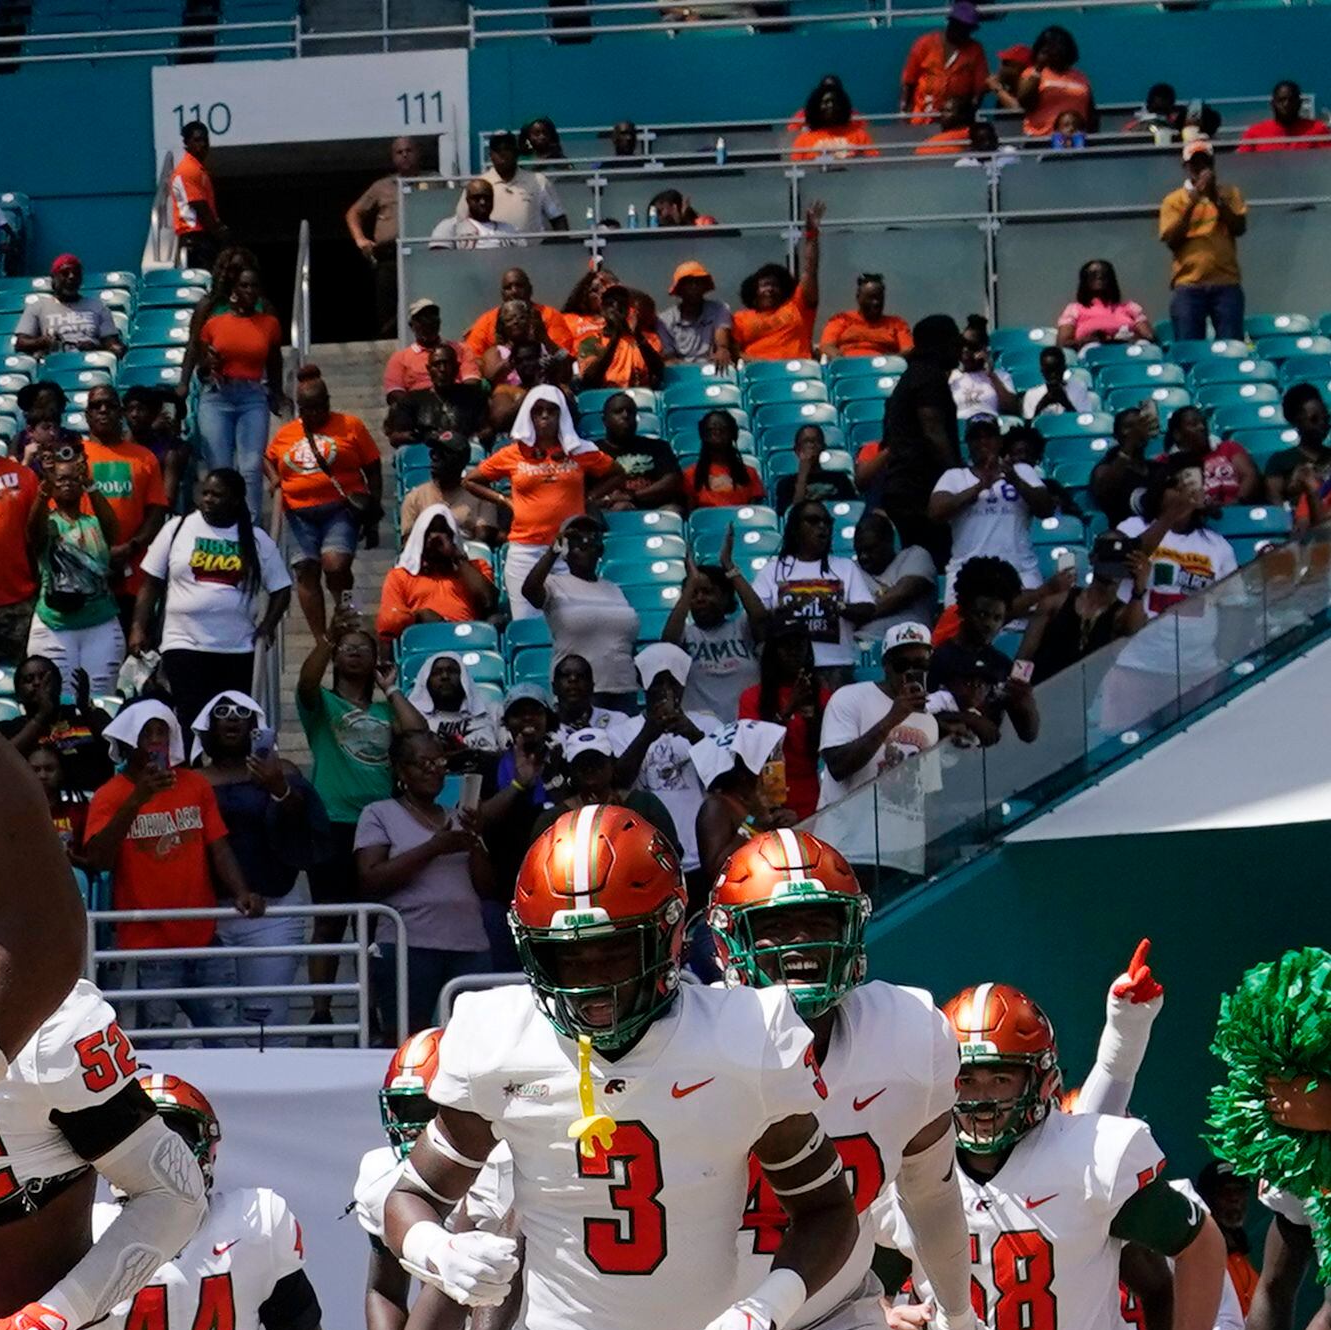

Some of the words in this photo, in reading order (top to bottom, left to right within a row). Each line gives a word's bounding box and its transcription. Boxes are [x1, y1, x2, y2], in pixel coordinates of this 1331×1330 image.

[172, 102, 232, 135] 110
[397, 90, 444, 125] 111
[564, 914, 595, 925] FAMU
[74, 1020, 137, 1093] 52
[577, 1119, 667, 1275] 3
